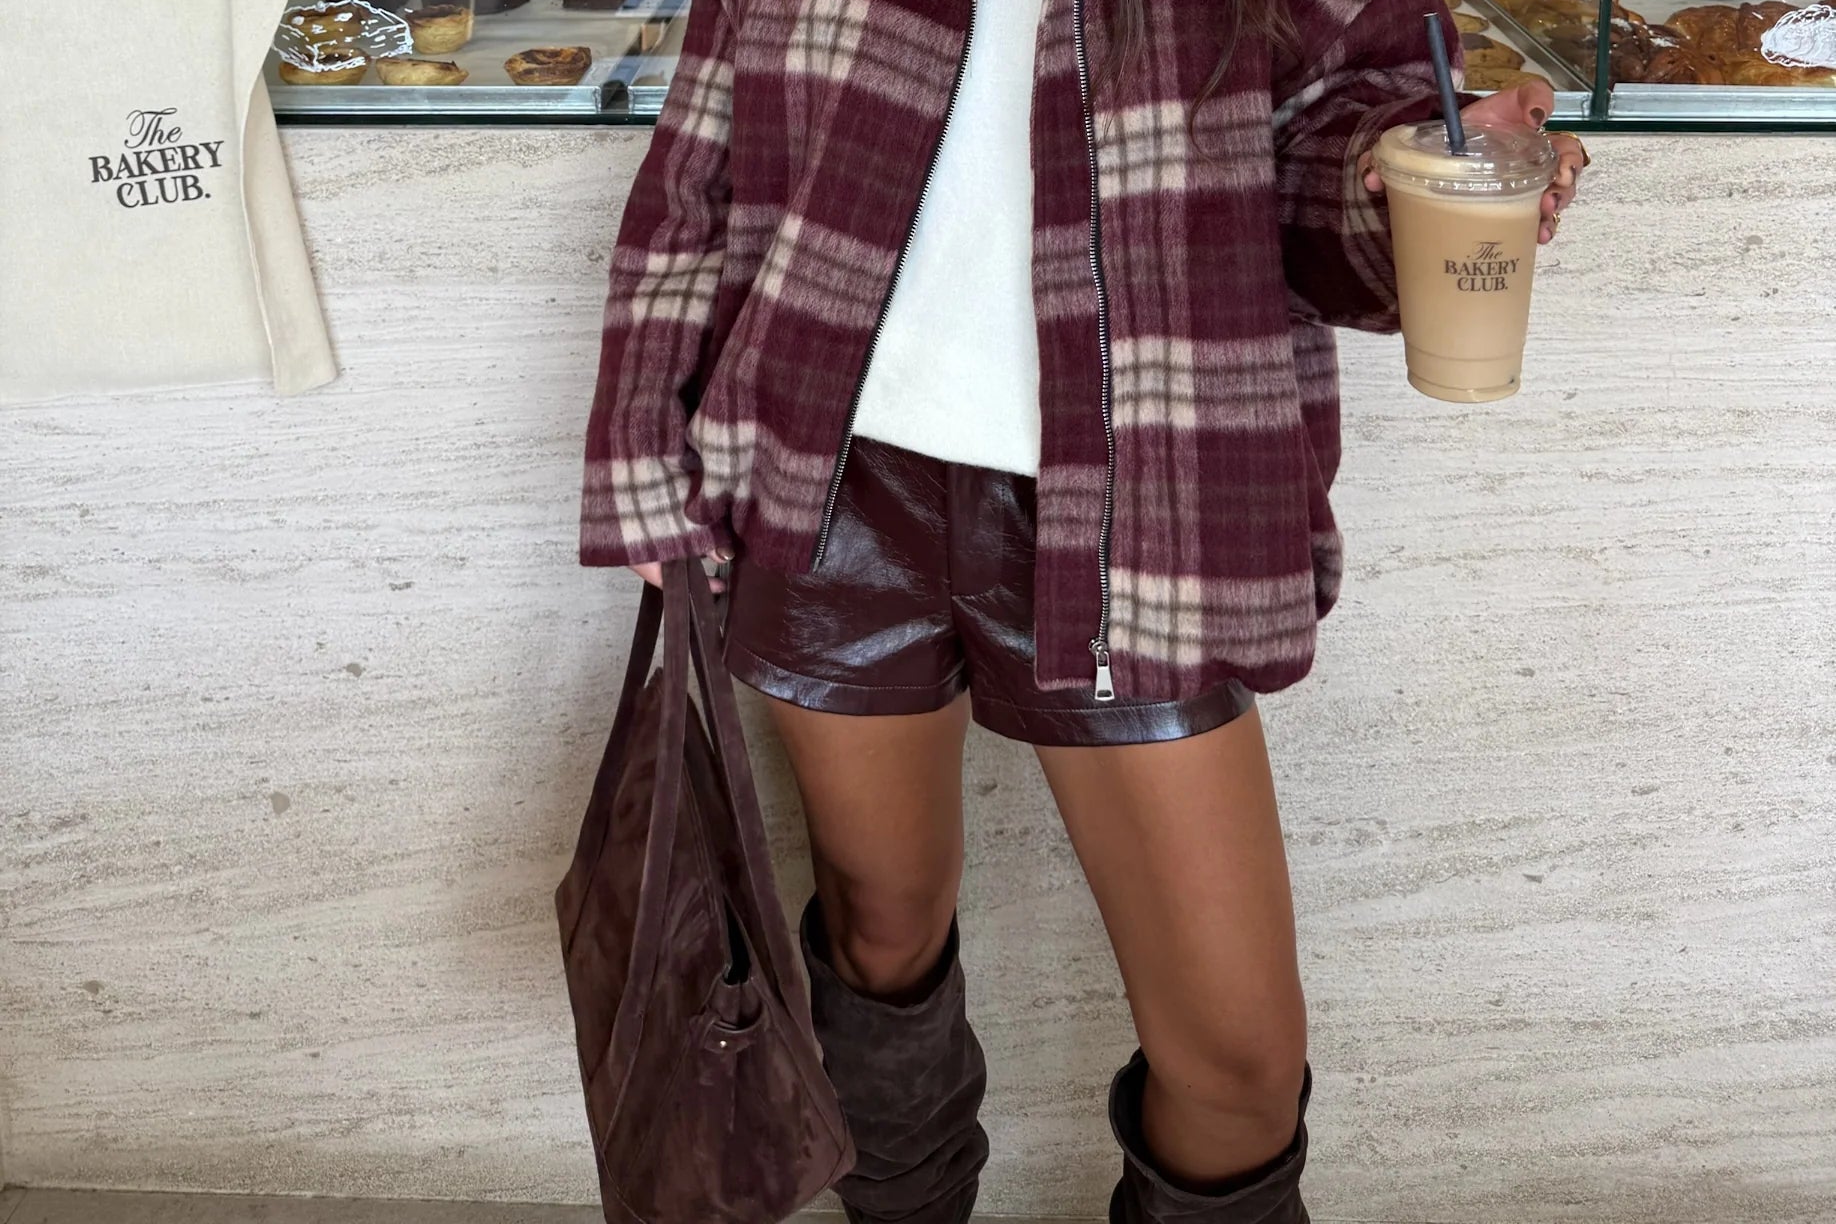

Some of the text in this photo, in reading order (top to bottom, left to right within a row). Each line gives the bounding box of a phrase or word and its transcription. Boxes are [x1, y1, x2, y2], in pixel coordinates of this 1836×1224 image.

[124, 108, 183, 148] The
[88, 140, 225, 183] BAKERY
[116, 174, 211, 209] CLUB.
[1467, 241, 1503, 261] The
[1443, 258, 1519, 276] BAKERY
[1457, 276, 1509, 292] CLUB.
